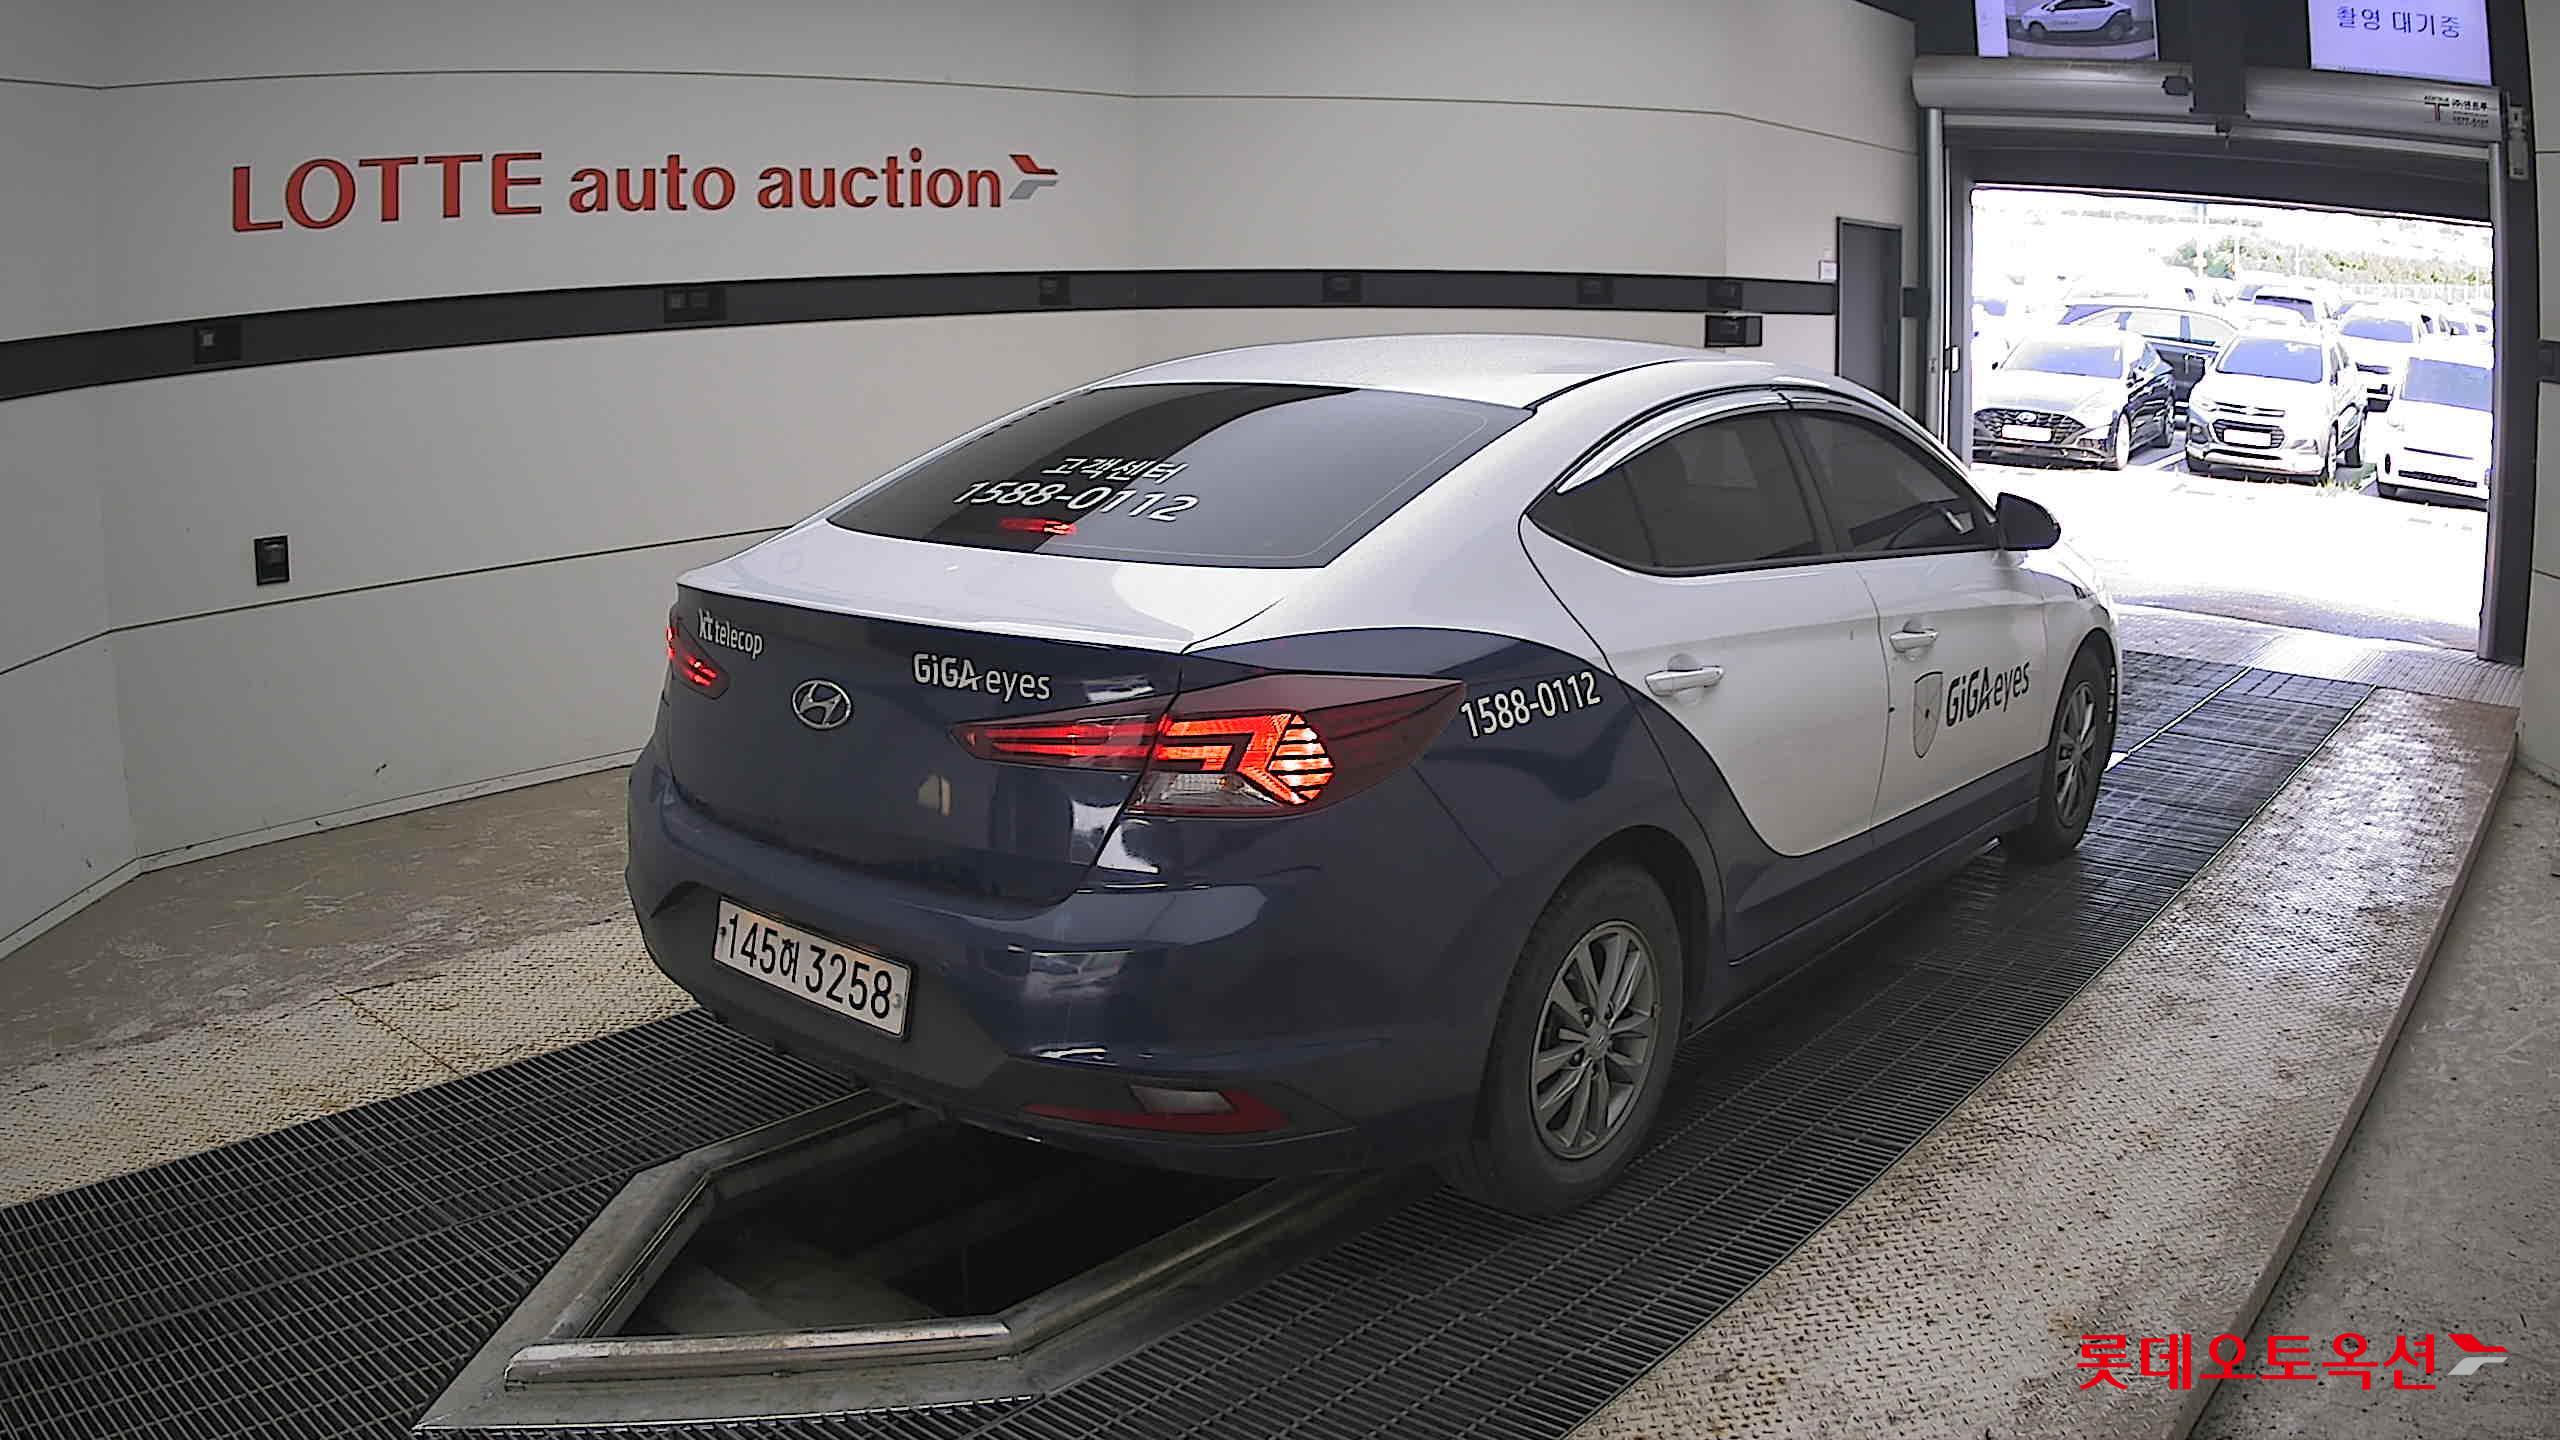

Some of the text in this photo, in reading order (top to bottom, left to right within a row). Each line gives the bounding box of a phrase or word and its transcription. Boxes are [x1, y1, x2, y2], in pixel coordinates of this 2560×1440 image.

[2336, 5, 2461, 39] 촬영 대기중
[232, 146, 1002, 233] LOTTE auto auction
[1040, 457, 1188, 485] 고객센터
[952, 480, 1199, 522] 1588-0112
[714, 620, 764, 661] telecop
[912, 652, 1052, 703] GiGA eyes
[1992, 661, 2031, 713] eyes
[1460, 670, 1601, 738] 1588-0112
